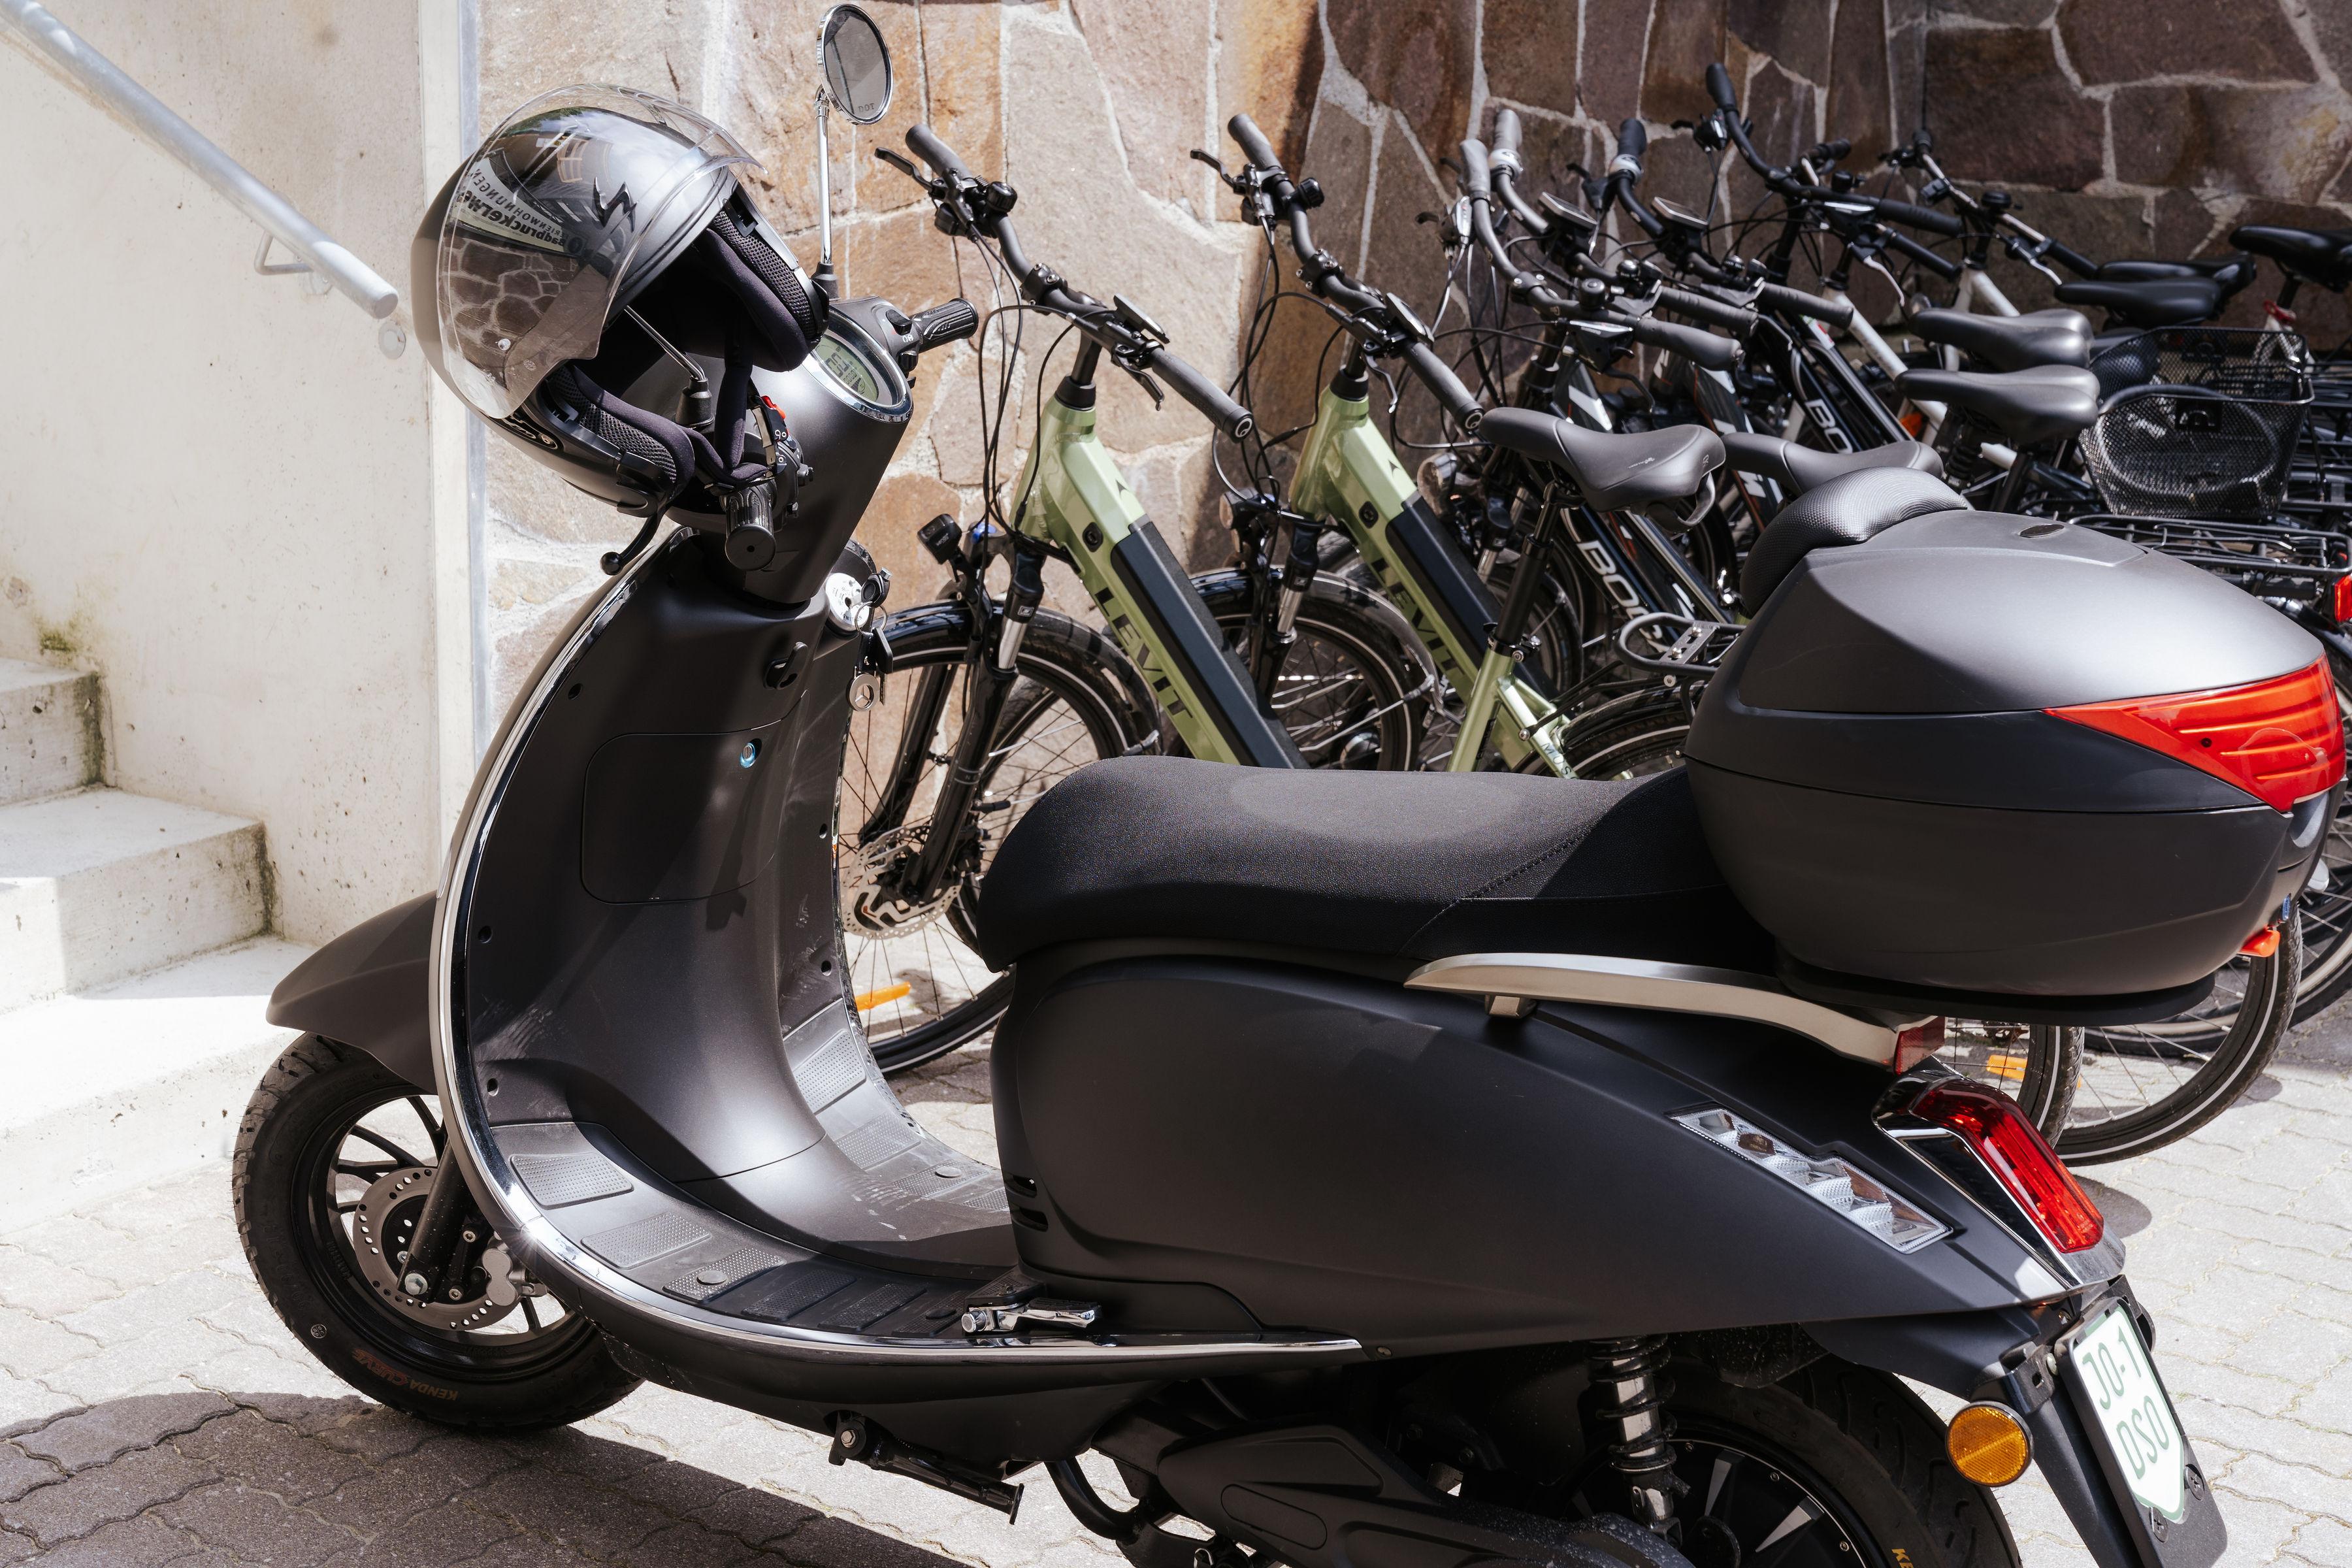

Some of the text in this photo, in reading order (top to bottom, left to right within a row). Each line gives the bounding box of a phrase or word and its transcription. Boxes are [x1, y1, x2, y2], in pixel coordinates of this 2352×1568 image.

[858, 103, 875, 113] DOT
[1094, 587, 1193, 719] LEVIT
[1371, 558, 1465, 675] LEVIT
[1541, 743, 1580, 779] MUS
[351, 1348, 458, 1401] KENDA CURVE
[2082, 1326, 2142, 1410] JO-1
[2116, 1396, 2170, 1480] DSO
